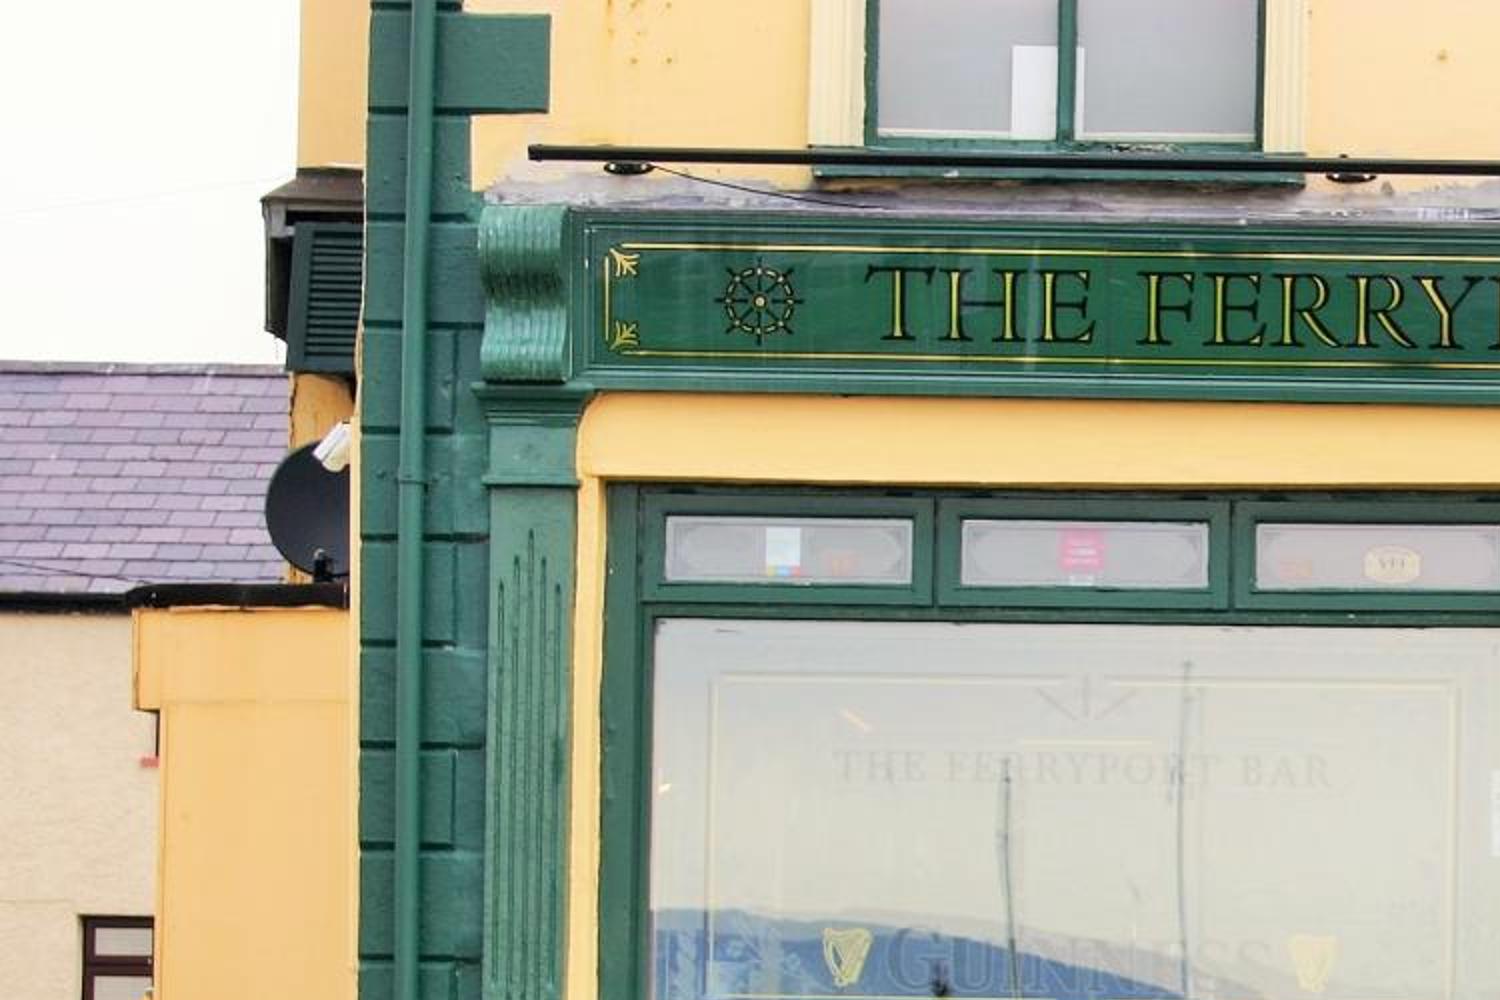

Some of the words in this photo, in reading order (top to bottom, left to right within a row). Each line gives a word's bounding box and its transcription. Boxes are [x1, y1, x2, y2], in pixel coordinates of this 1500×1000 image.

[866, 264, 1096, 344] THE
[837, 749, 926, 785] THE
[947, 749, 1219, 788] FERRYPORT
[1244, 754, 1332, 789] BAR
[889, 927, 1272, 996] GUINNESS
